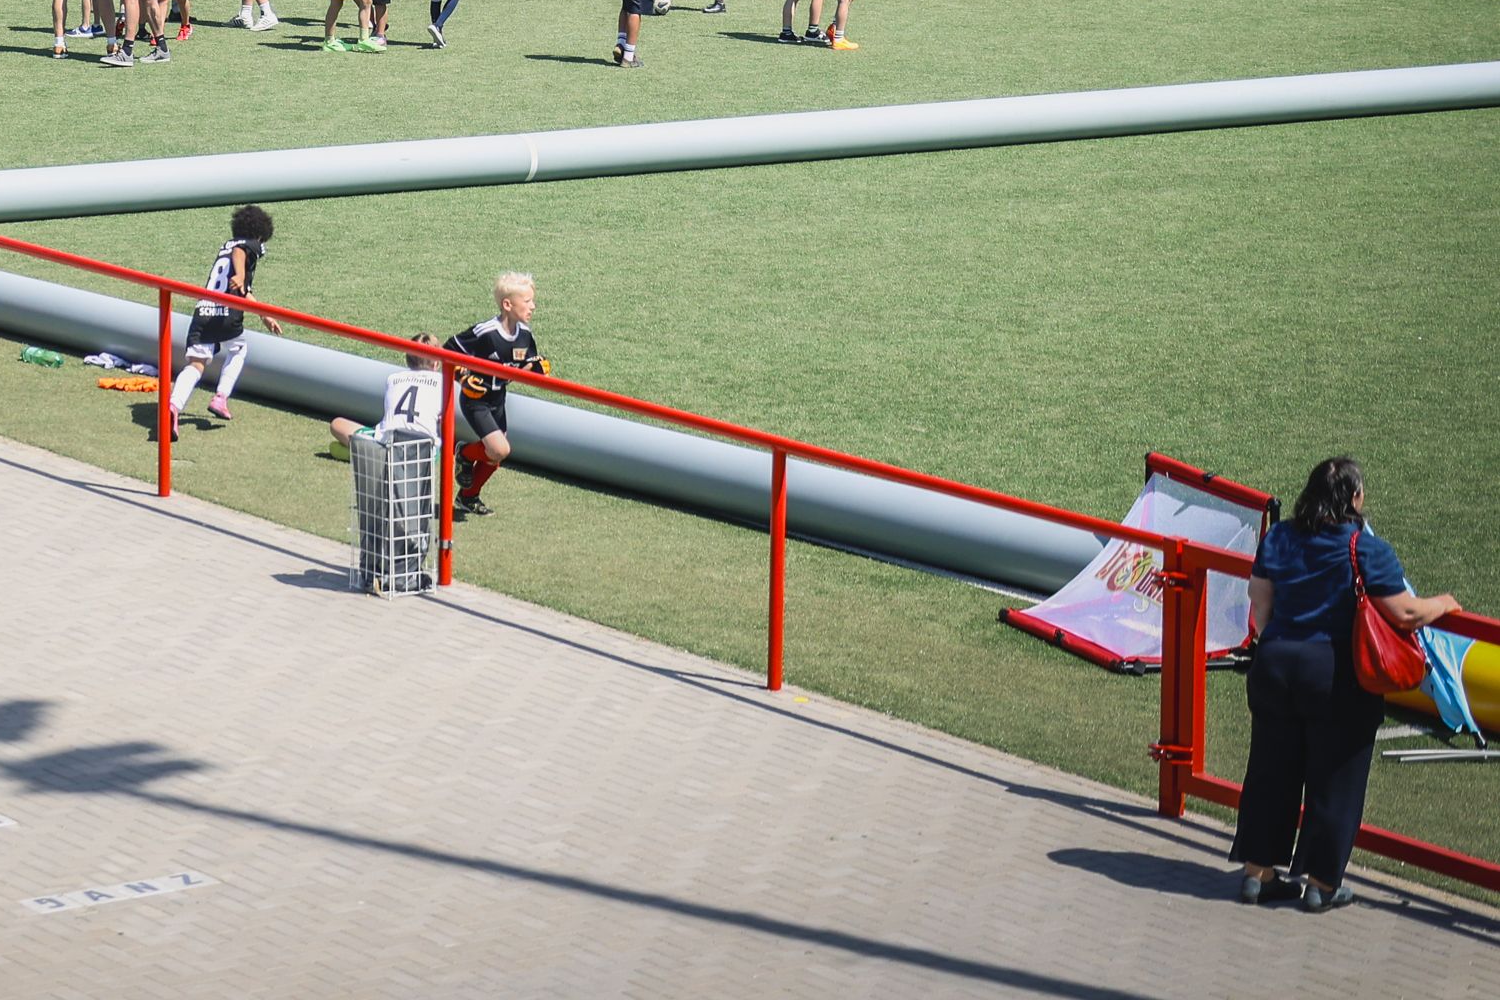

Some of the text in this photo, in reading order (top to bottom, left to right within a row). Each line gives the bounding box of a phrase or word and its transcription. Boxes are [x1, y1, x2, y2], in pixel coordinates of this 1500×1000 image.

[206, 257, 231, 294] 8
[198, 306, 230, 317] SCHULE
[394, 385, 420, 424] 4
